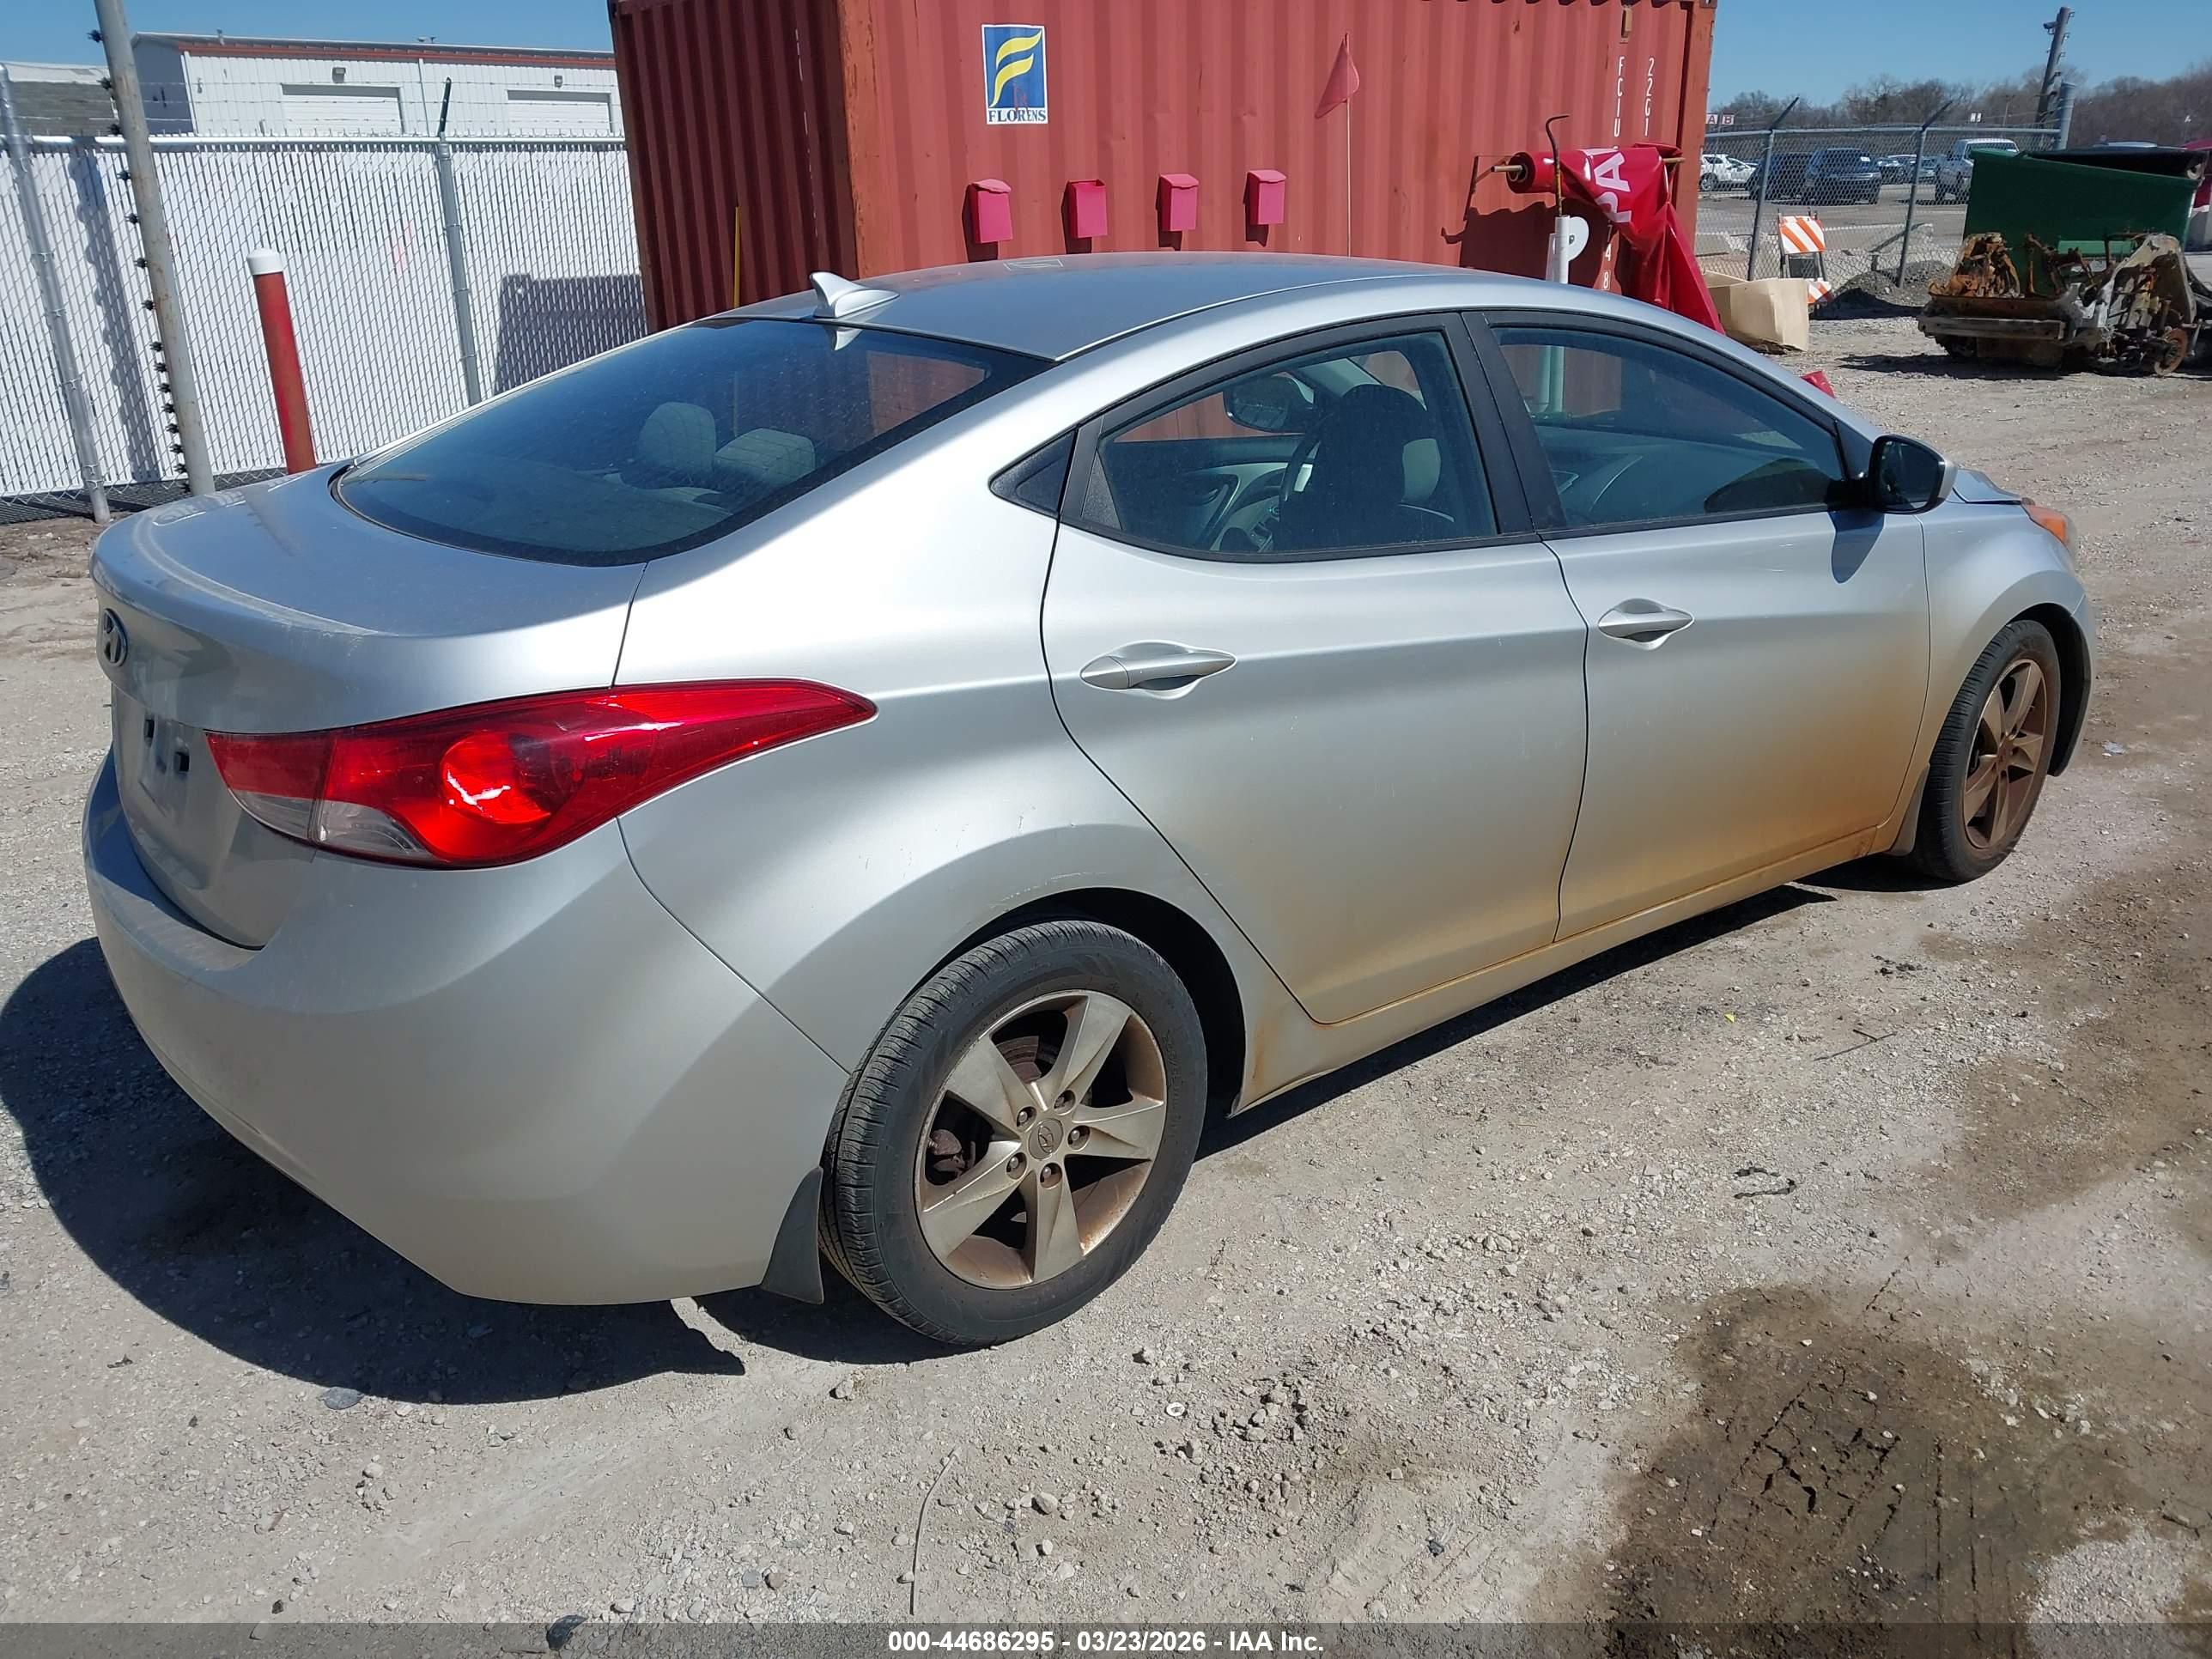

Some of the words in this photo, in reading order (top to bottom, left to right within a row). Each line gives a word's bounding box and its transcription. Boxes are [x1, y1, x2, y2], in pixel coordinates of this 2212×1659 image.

[1613, 56, 1625, 137] FCIU
[988, 109, 1047, 122] FLORENS
[1707, 114, 1716, 124] A
[1724, 115, 1733, 125] B
